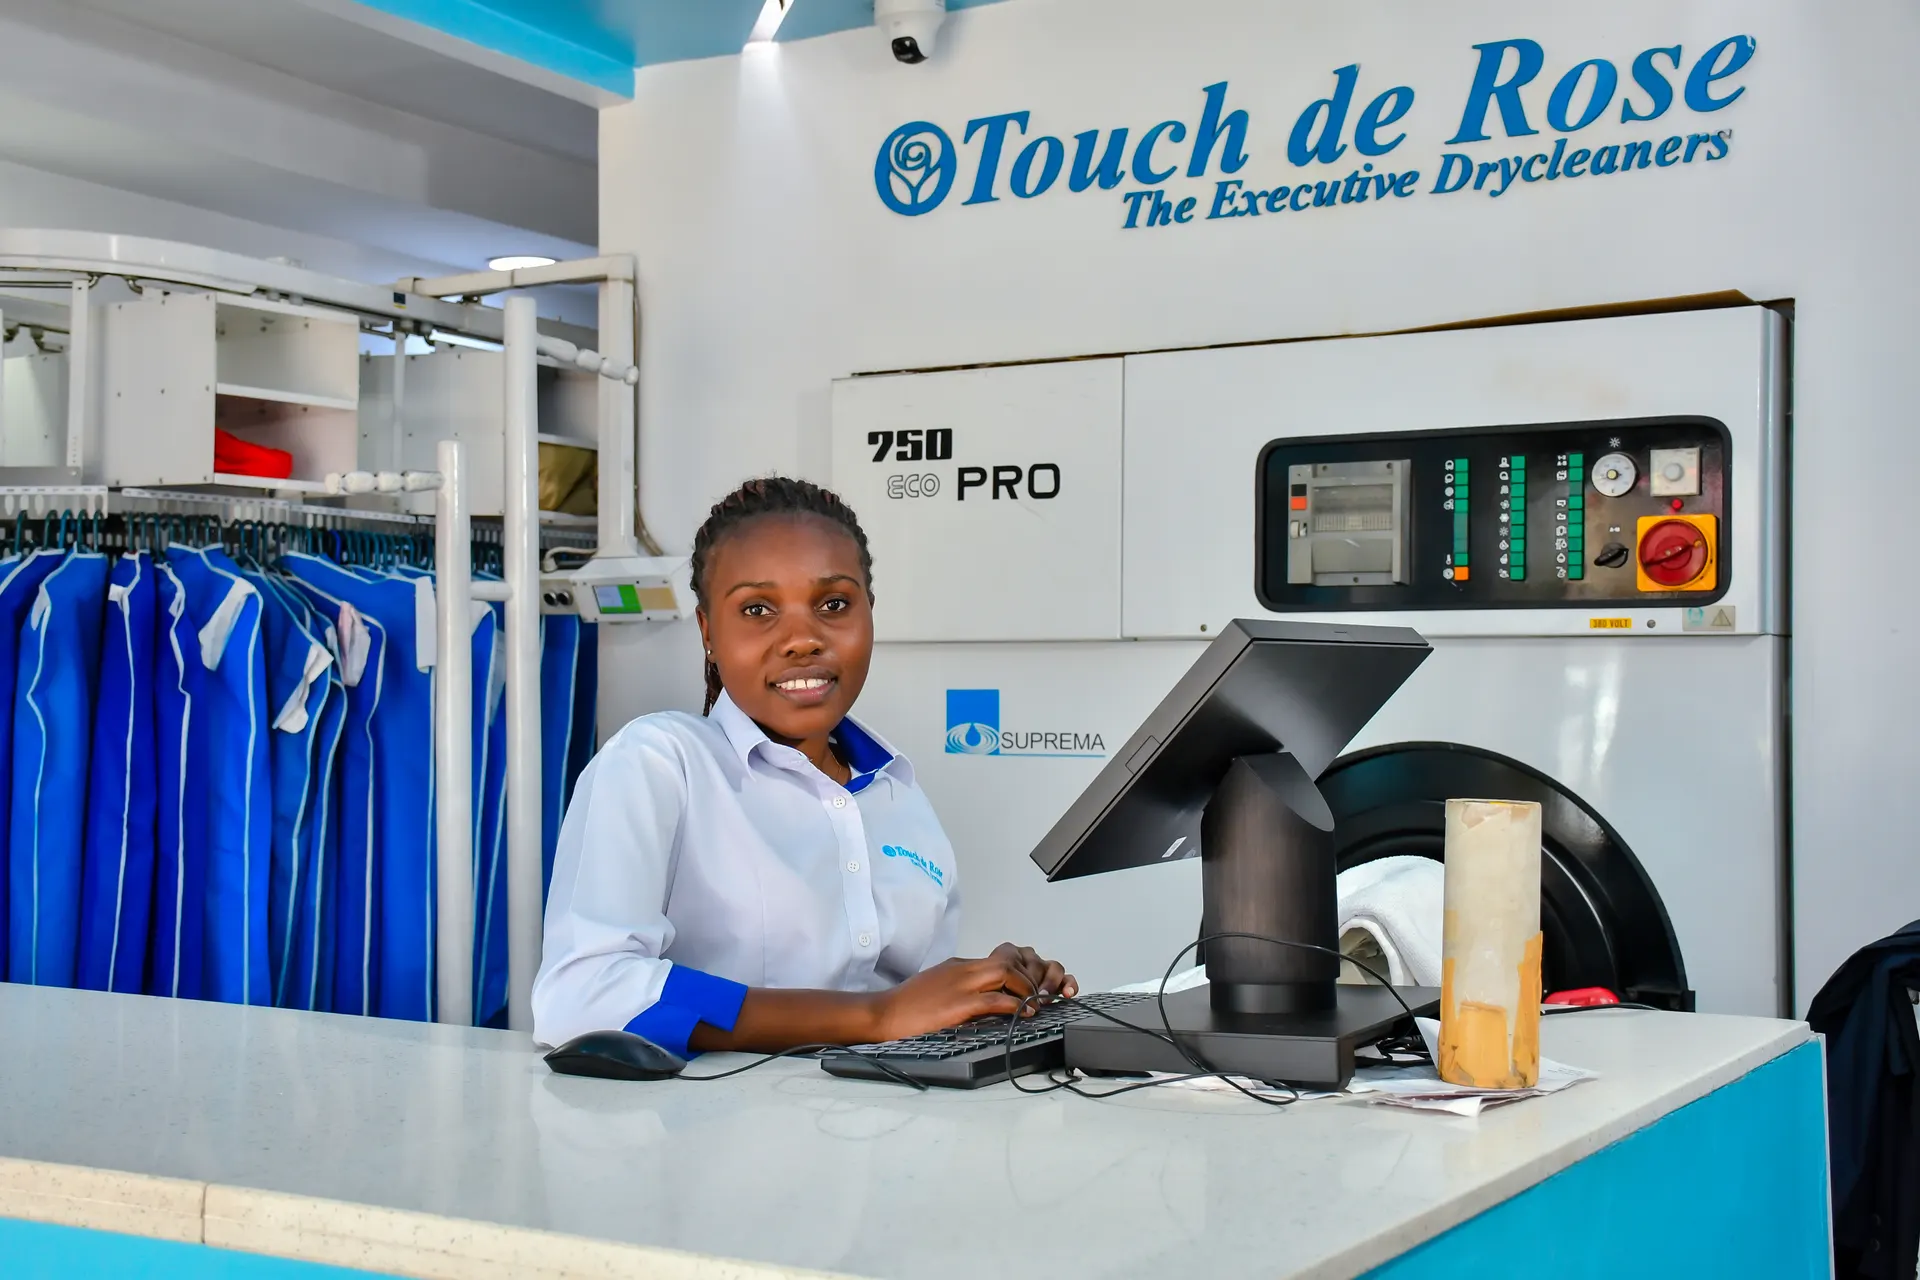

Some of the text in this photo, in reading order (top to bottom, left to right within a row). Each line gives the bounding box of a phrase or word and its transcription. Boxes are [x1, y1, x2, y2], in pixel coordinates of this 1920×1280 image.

[962, 34, 1757, 206] Touch de Rose
[1122, 128, 1733, 229] The Executive Drycleaners
[868, 428, 953, 462] 750
[887, 463, 1061, 501] ECO PRO
[1610, 619, 1629, 628] VOLT
[1001, 731, 1106, 750] SUPREMA
